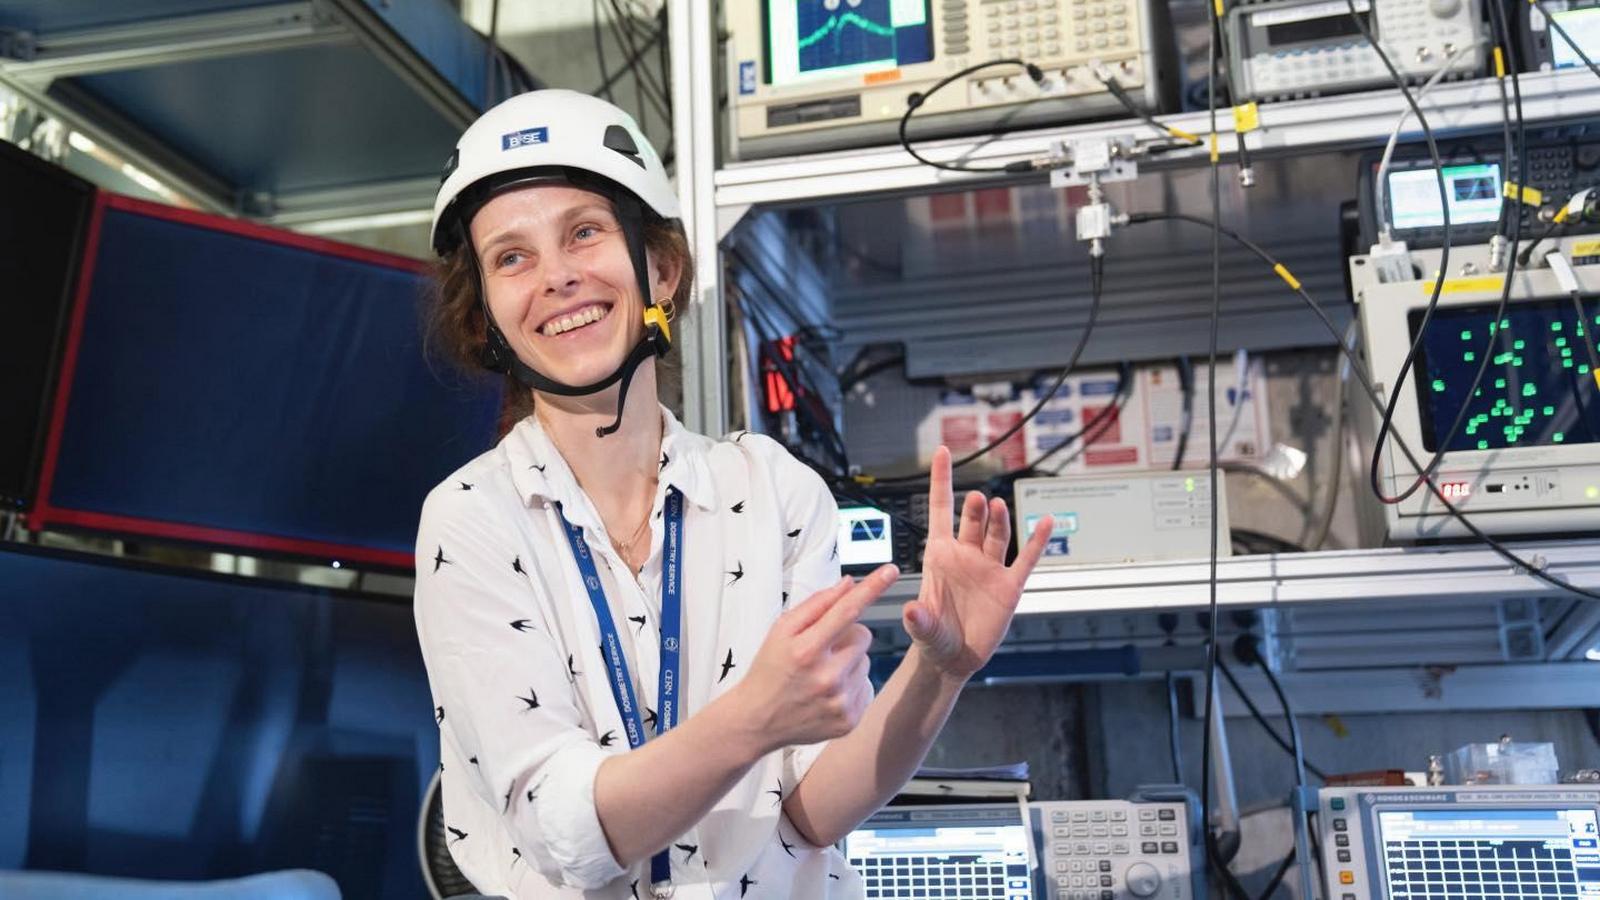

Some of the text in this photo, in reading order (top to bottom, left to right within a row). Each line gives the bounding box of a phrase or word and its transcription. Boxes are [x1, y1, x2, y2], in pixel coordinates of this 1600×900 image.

[668, 494, 679, 595] CERN DOSIMETRY SERVICE
[616, 667, 632, 713] DOSIMETRY
[663, 669, 673, 732] CERN DOSIME
[626, 718, 639, 745] CERN
